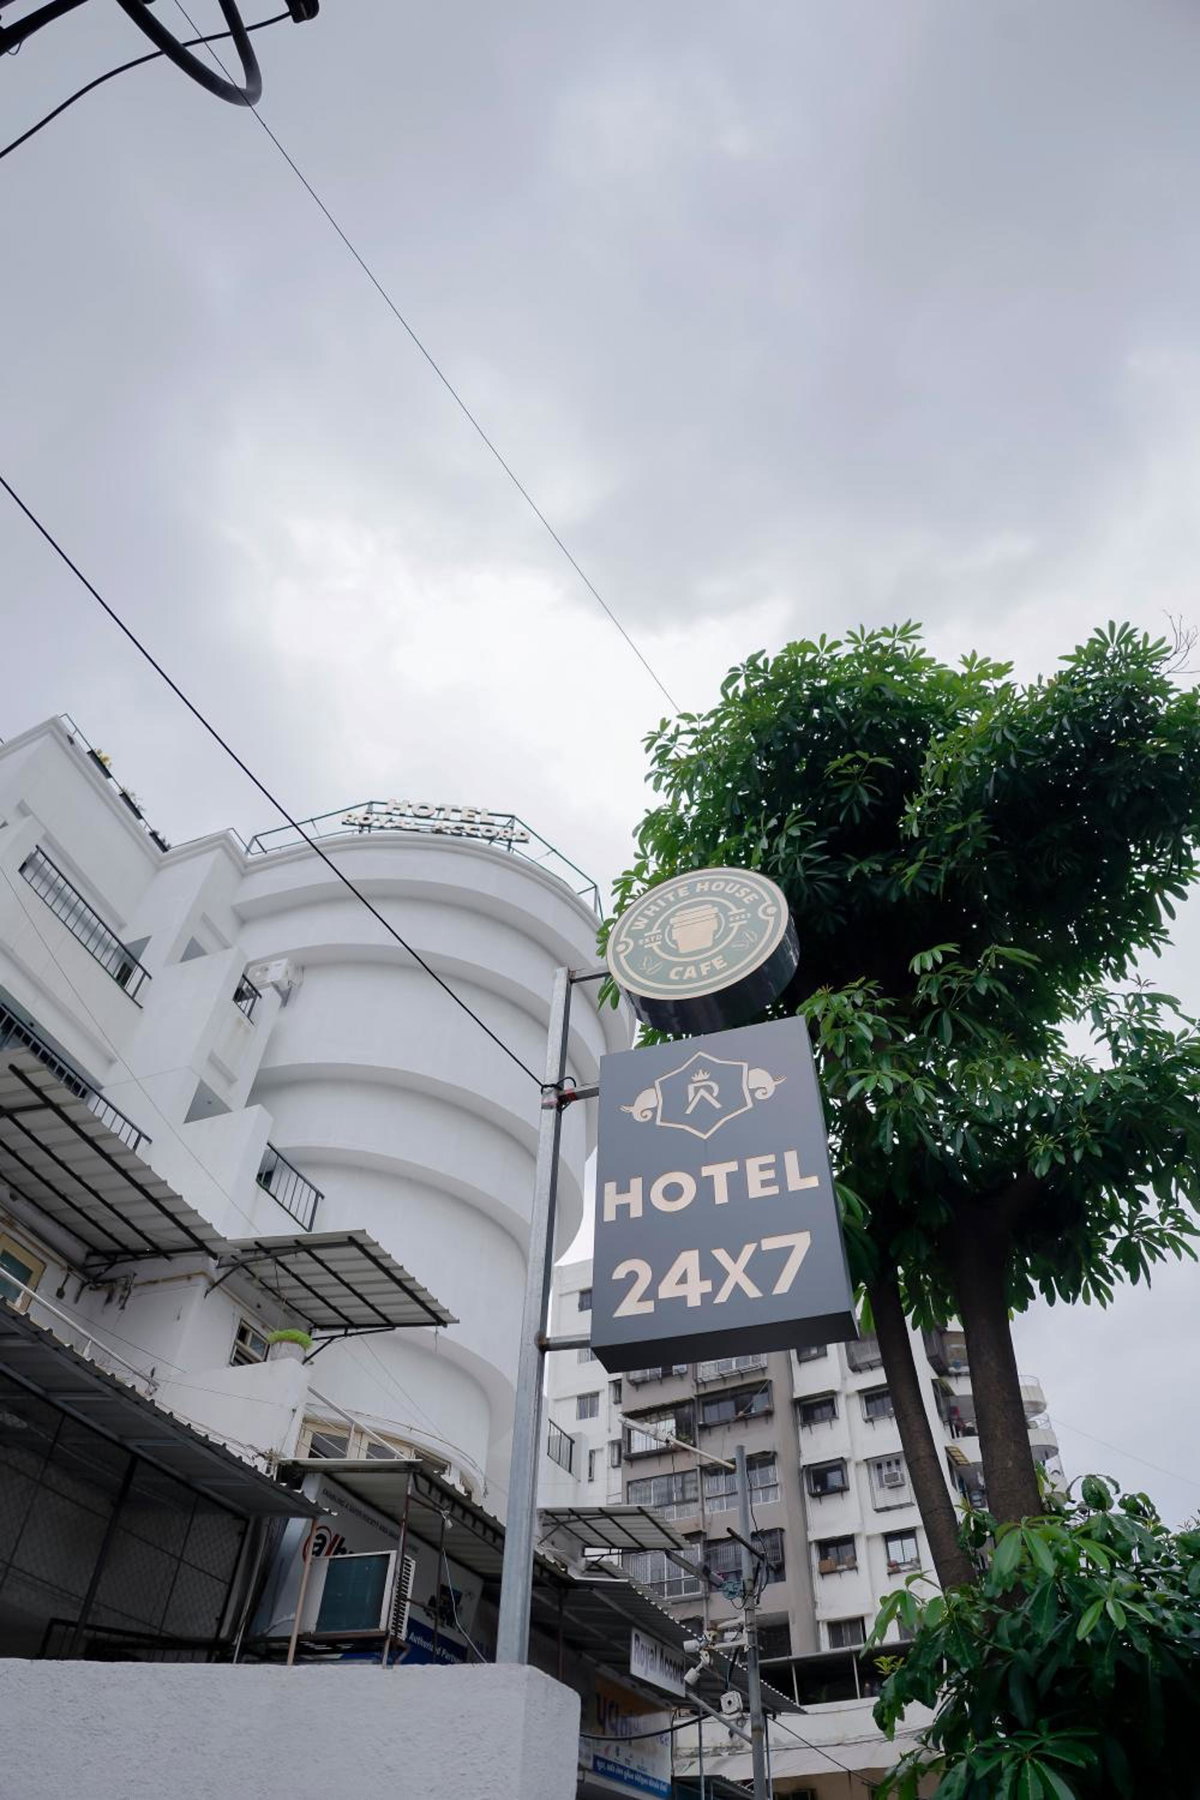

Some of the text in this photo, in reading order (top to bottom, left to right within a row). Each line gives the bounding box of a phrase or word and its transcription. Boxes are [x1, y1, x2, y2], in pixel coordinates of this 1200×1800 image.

[386, 799, 495, 826] HOTEL
[631, 881, 759, 930] WHITE HOUSE
[669, 955, 728, 980] CAFE
[603, 1150, 819, 1223] HOTEL
[611, 1230, 812, 1319] 24X7
[634, 1633, 657, 1676] Royal
